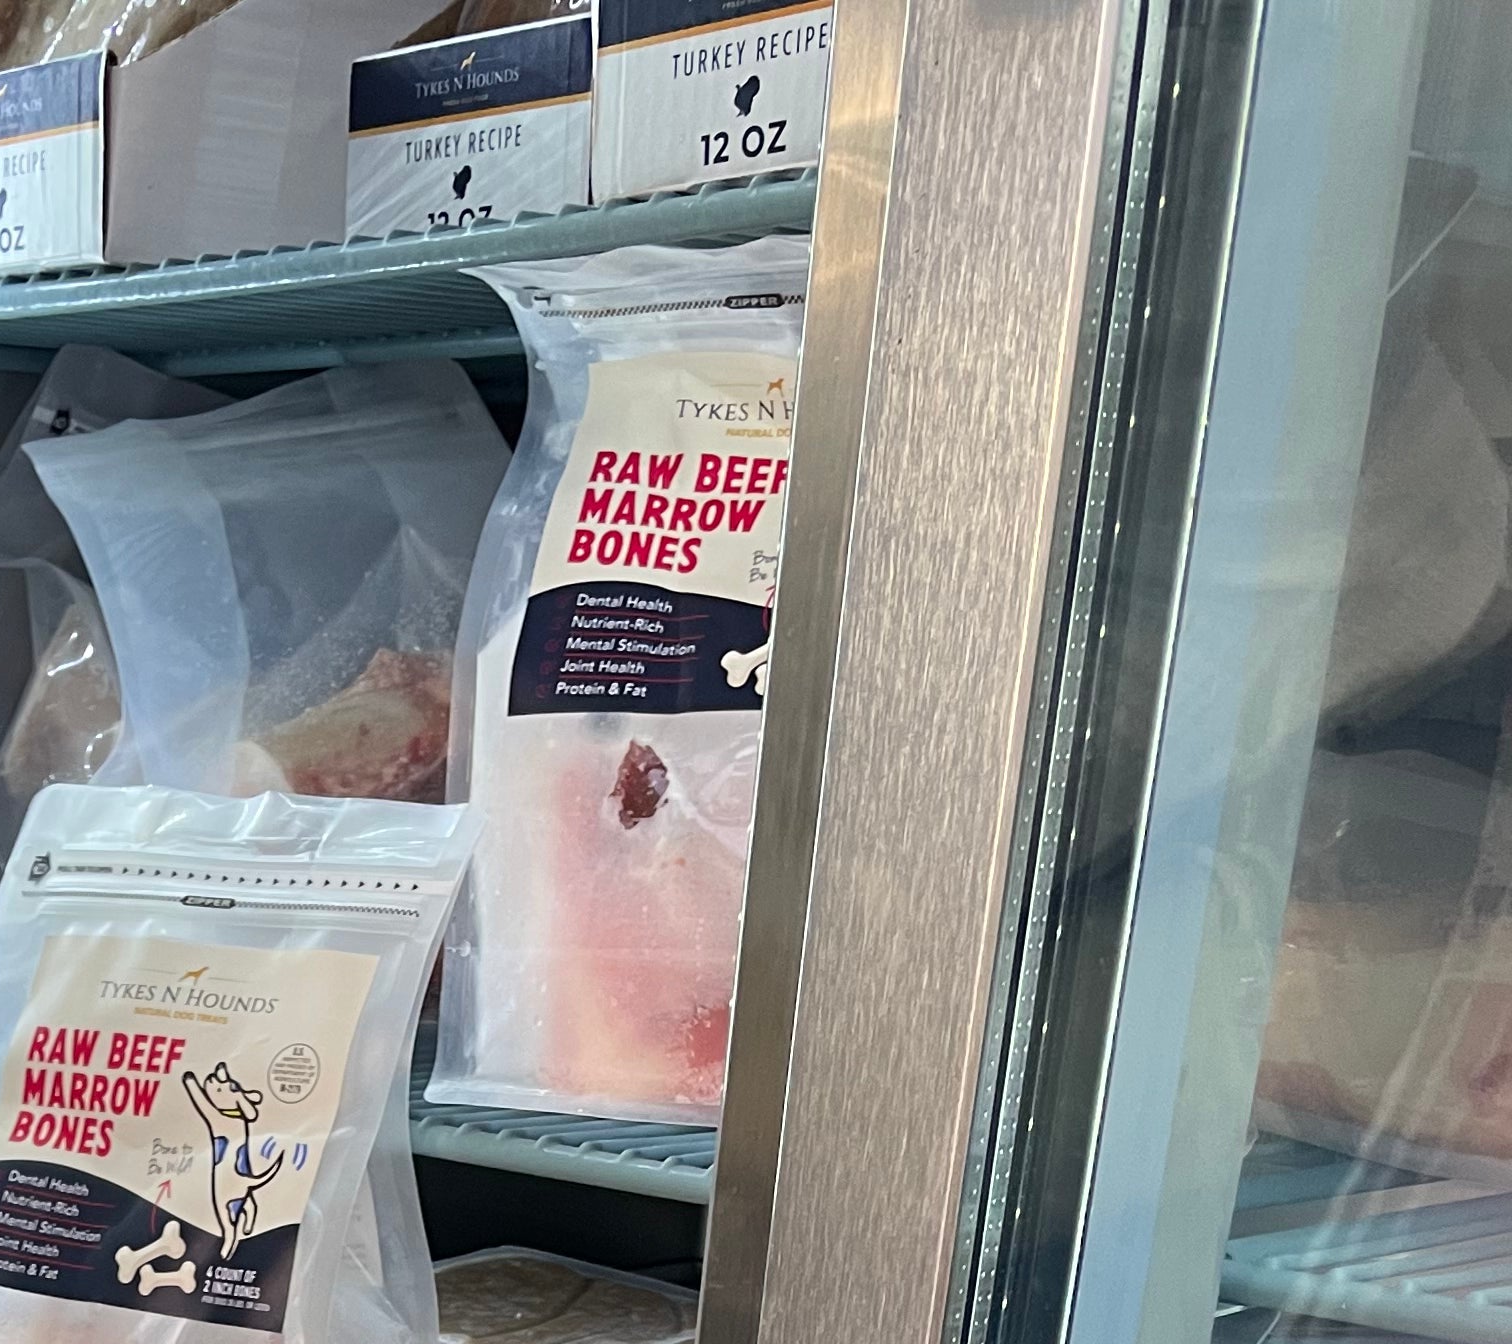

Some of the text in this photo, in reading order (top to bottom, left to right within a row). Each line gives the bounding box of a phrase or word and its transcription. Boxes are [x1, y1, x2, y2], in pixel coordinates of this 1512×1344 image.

[673, 22, 829, 80] TURKEY RECIPE
[415, 66, 520, 99] TYKES N HOUNDS
[406, 124, 522, 164] TURKEY RECIPE
[700, 119, 787, 167] 12 OZ
[3, 150, 47, 178] RECIPE
[729, 296, 779, 308] ZIPPER
[675, 398, 750, 422] TYKES
[758, 399, 775, 421] N
[725, 427, 773, 439] NATURAL
[588, 450, 788, 495] RAW BEEF
[577, 487, 767, 533] MARROW
[567, 528, 703, 575] BONES
[576, 592, 673, 614] Dental Health
[570, 615, 665, 634] Nutrient-Rich
[565, 637, 697, 657] Mental Stimulation
[559, 658, 646, 675] Joint Health
[554, 681, 648, 698] Protein & Fat
[99, 980, 280, 1015] TYKES N HOUNDS
[27, 1025, 187, 1075] RAW BEEF
[21, 1067, 162, 1118] MARROW
[8, 1110, 115, 1158] BONES
[7, 1169, 90, 1197] Dental Health
[1, 1189, 80, 1217] Nutrient-Rich
[39, 1220, 102, 1243] Stimulation
[20, 1239, 60, 1257] Health
[26, 1262, 38, 1277] &
[38, 1265, 59, 1280] Fat
[202, 1279, 211, 1293] 2
